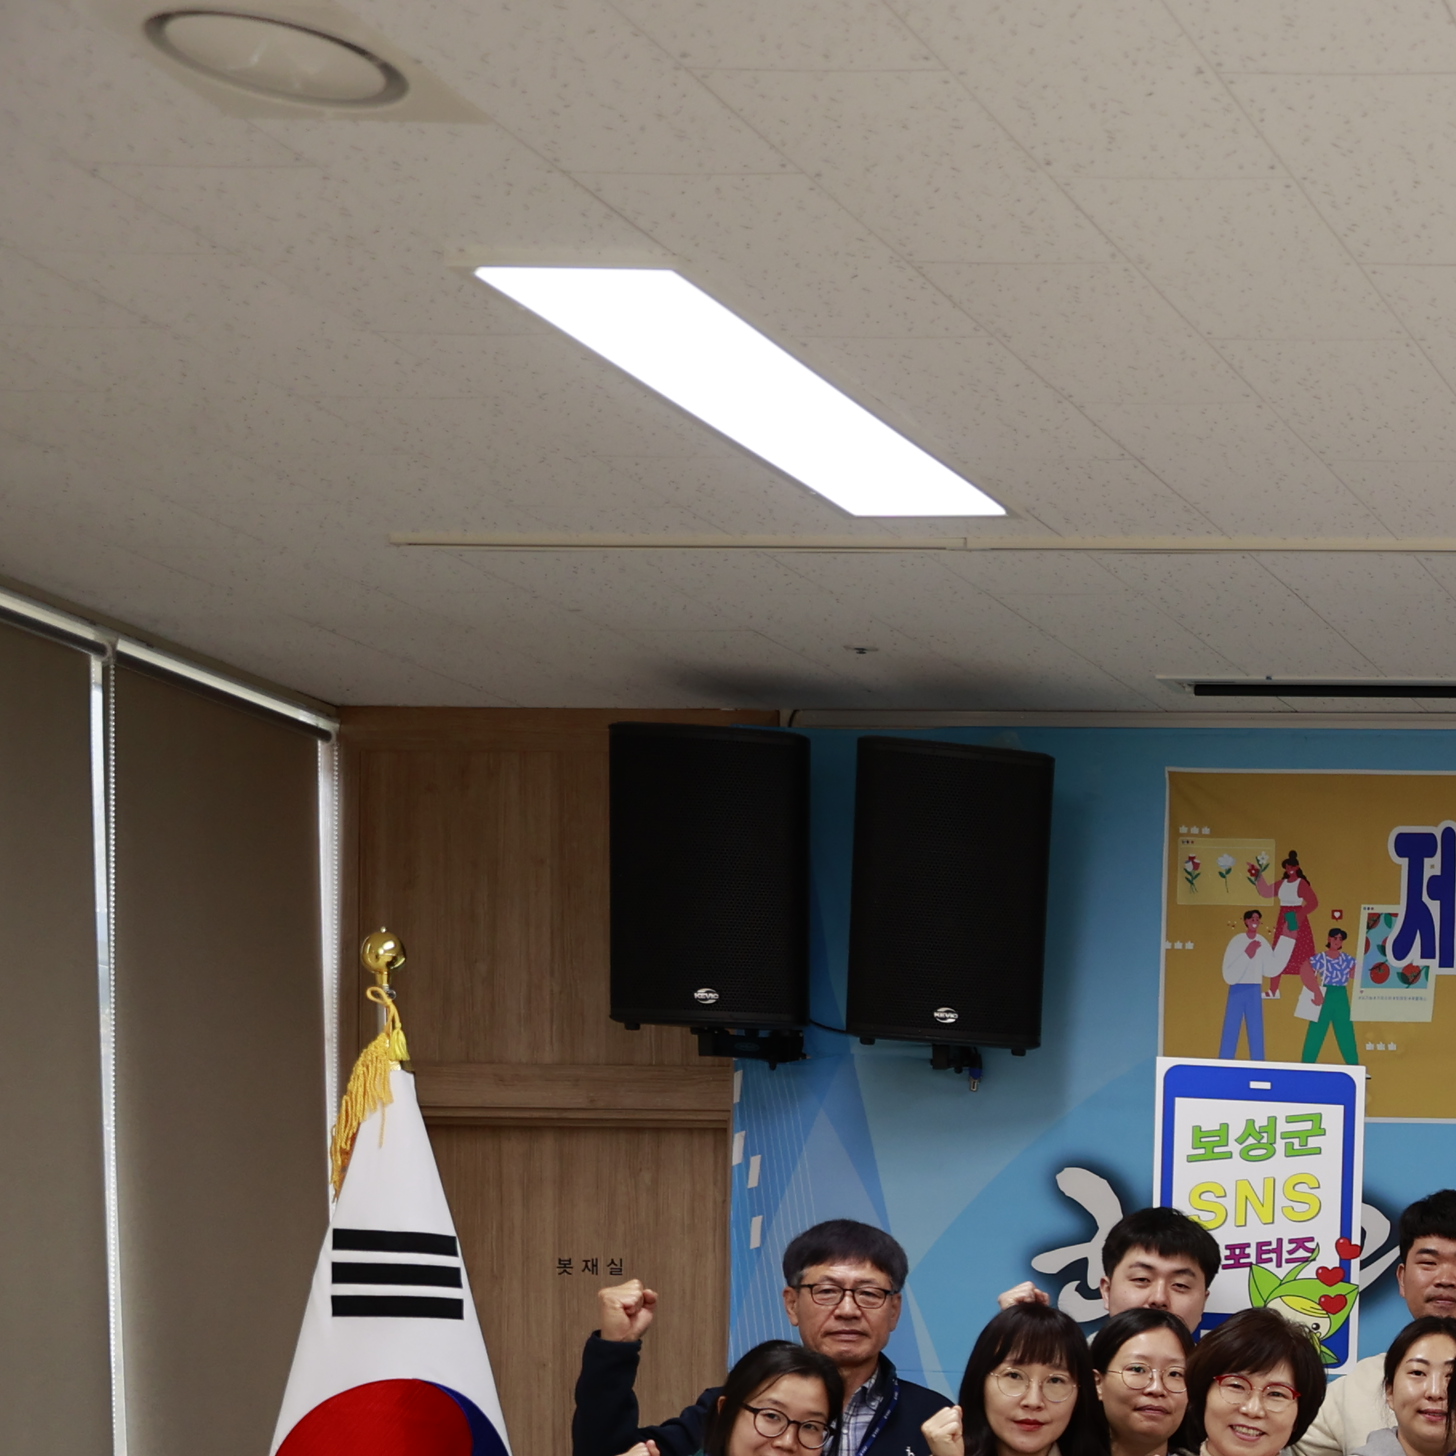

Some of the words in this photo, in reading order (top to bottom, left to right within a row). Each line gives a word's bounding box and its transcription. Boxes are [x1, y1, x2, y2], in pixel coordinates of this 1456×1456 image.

[1186, 1112, 1327, 1163] 보성군
[1187, 1172, 1322, 1231] SNS
[1221, 1236, 1317, 1270] 포터즈
